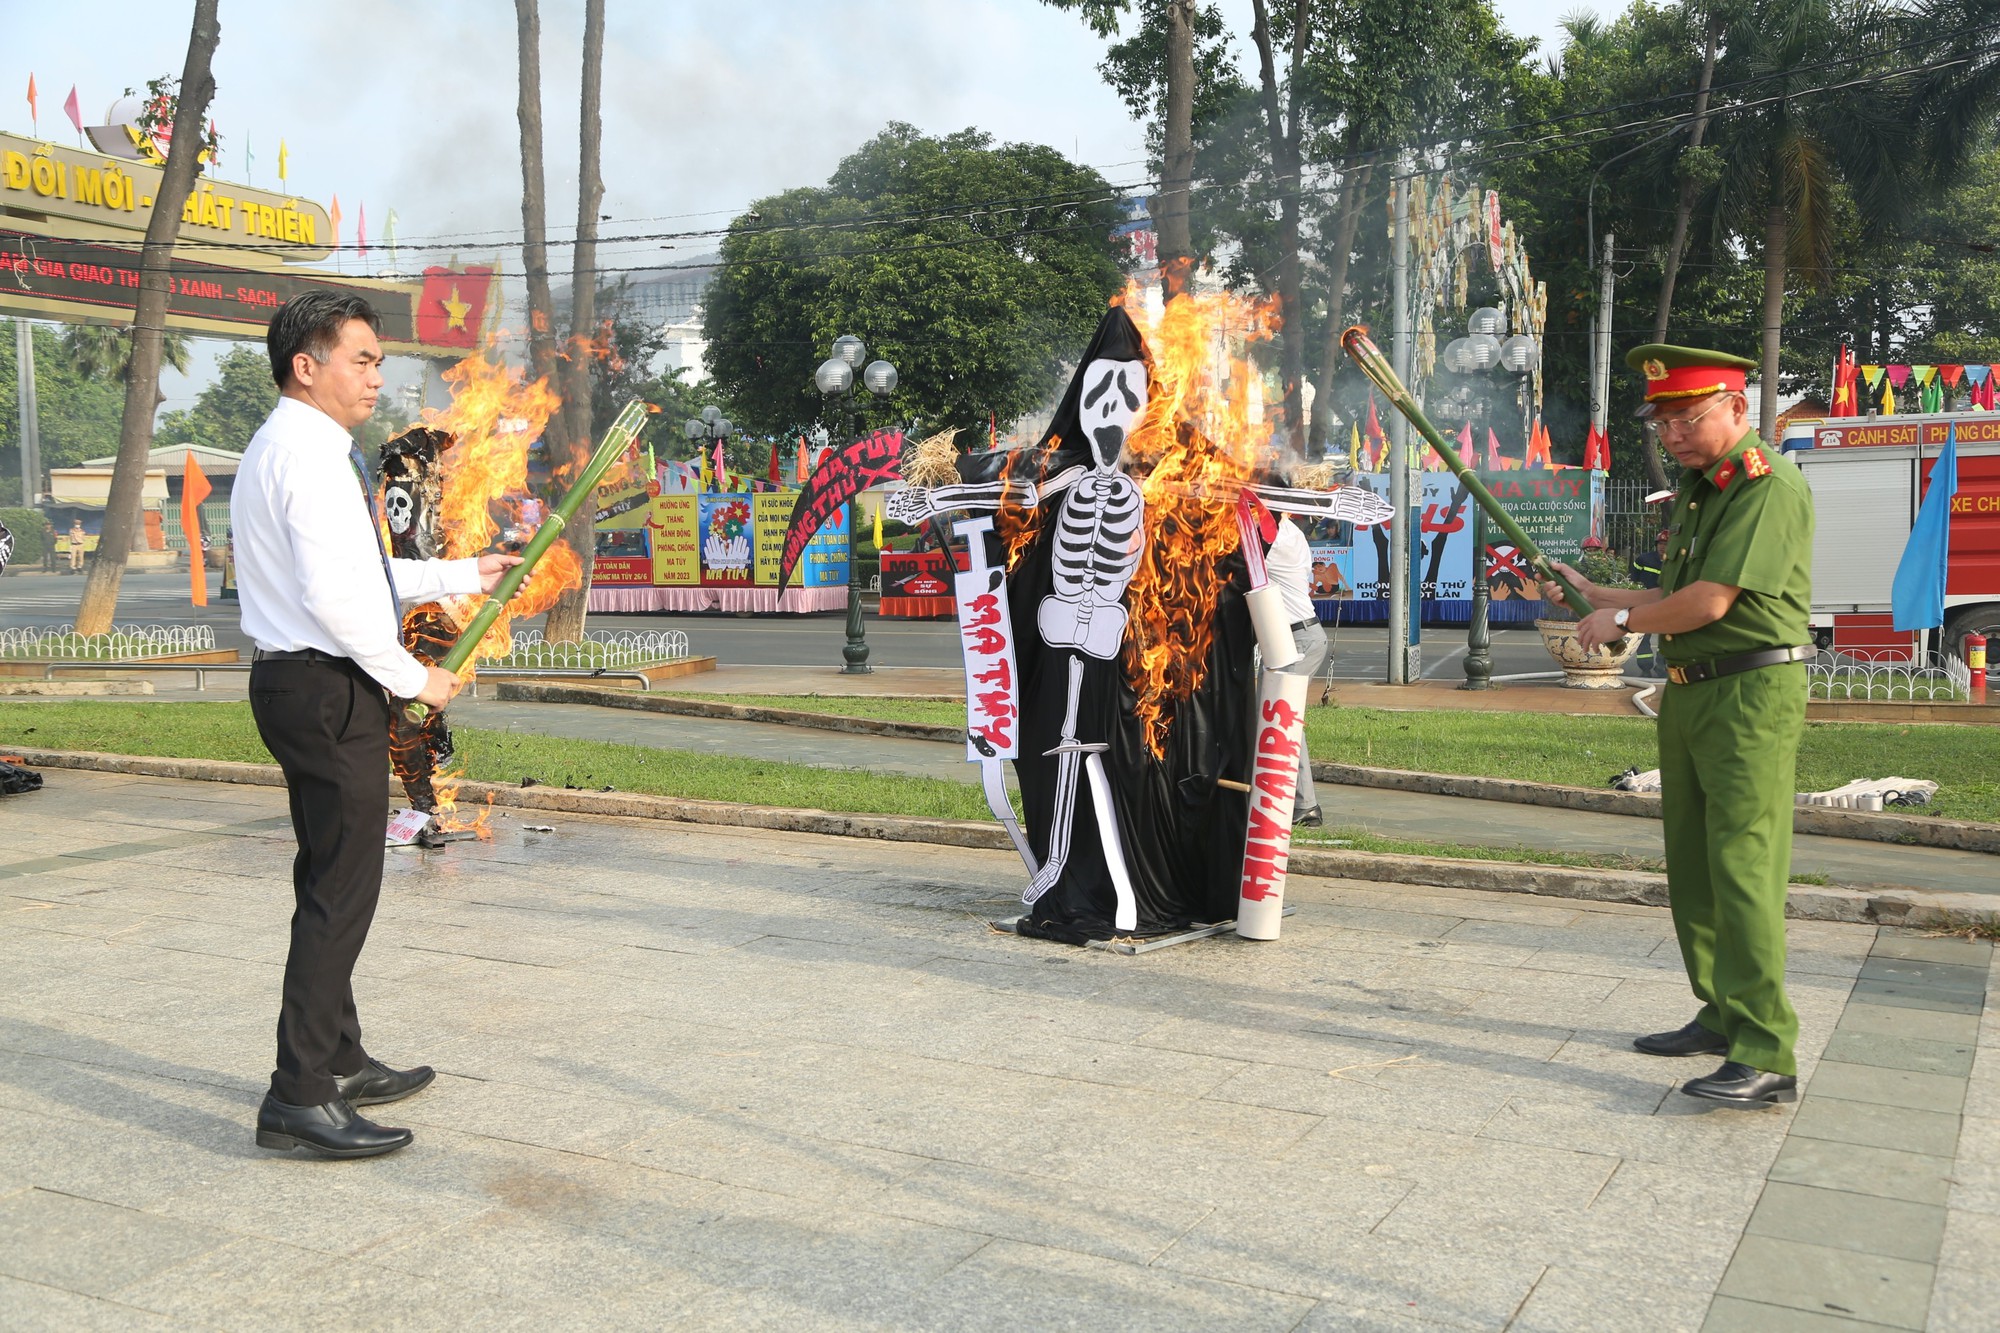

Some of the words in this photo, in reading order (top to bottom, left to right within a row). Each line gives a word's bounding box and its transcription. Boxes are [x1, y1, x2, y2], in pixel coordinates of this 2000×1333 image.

[74, 160, 135, 212] MỚI
[182, 183, 235, 231] HÁT
[241, 198, 316, 245] TRIỂN
[34, 257, 67, 279] GIA
[69, 263, 114, 286] GIAO
[180, 278, 223, 300] XANH
[237, 287, 278, 311] SẠCH
[1848, 427, 1887, 446] CẢNH
[1890, 425, 1917, 444] SÁT
[811, 457, 844, 493] MA
[1520, 500, 1537, 511] CỦA
[1539, 500, 1562, 512] CUỘC
[1563, 499, 1586, 510] SỐNG
[1951, 497, 1972, 512] XE
[1545, 515, 1557, 523] MA
[1559, 513, 1573, 523] TÚY
[634, 573, 648, 581] 26/6
[677, 572, 690, 580] 2023
[1356, 581, 1390, 590] KHÔN
